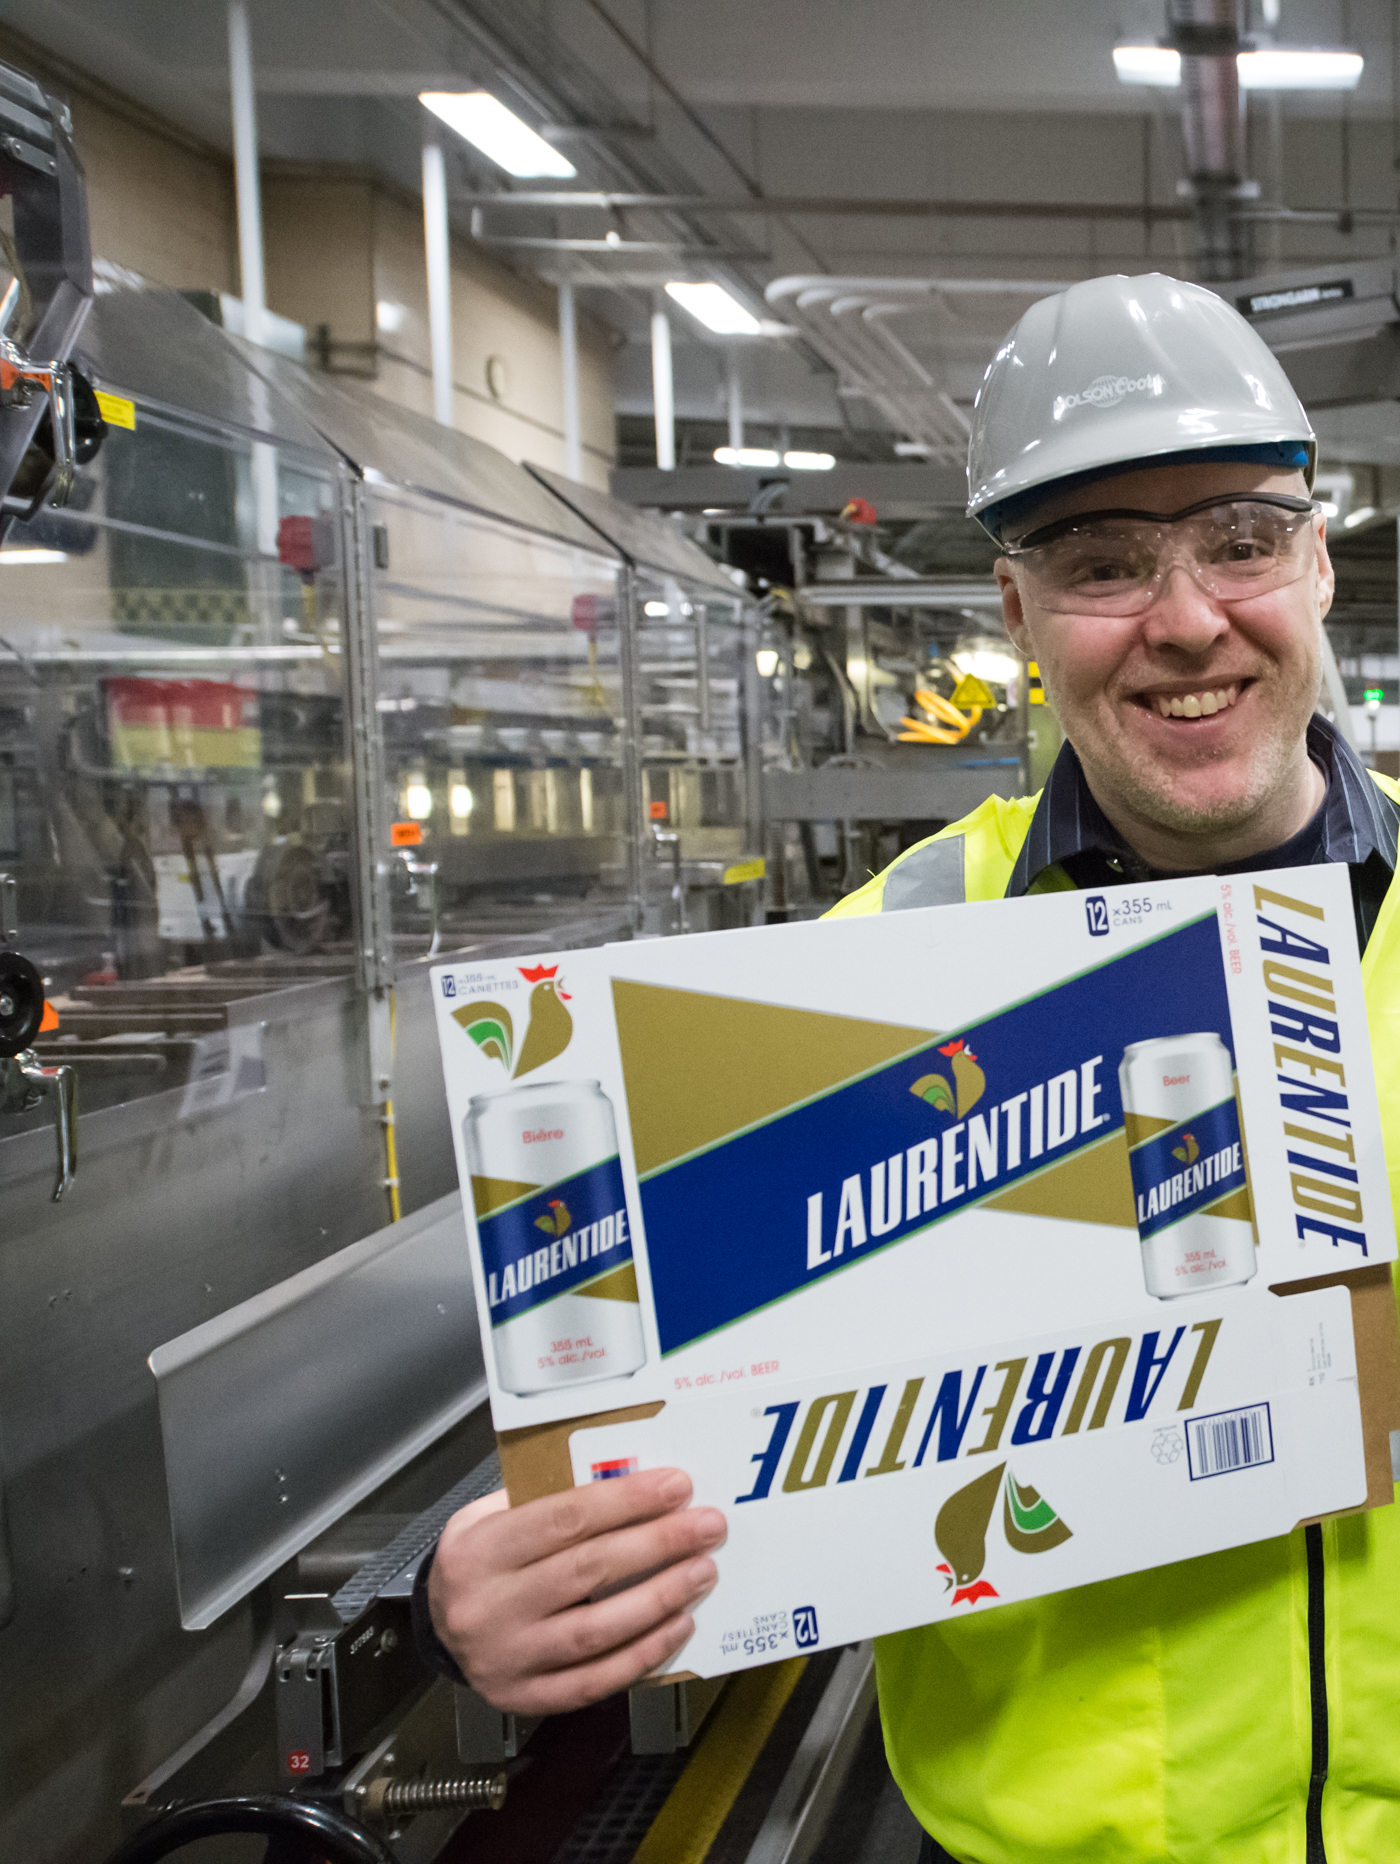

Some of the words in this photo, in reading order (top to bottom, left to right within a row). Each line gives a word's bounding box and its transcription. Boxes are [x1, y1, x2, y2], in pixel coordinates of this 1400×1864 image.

[1116, 373, 1163, 396] Coor
[1086, 900, 1108, 931] 12
[1113, 916, 1143, 927] CANS
[1220, 884, 1232, 899] 5%
[1229, 949, 1242, 975] BEER
[442, 977, 456, 997] 12
[458, 980, 519, 995] CANETTES
[1162, 1073, 1191, 1087] Beer
[1252, 883, 1369, 1257] LAURENTIDE
[522, 1128, 564, 1144] Bière
[806, 1055, 1104, 1270] LAURENTIDE
[1138, 1141, 1243, 1224] LAURENTIDE
[488, 1208, 630, 1308] LAURENTIDE
[537, 1355, 555, 1369] 5%
[674, 1376, 692, 1390] 5%
[750, 1360, 780, 1376] BEER
[734, 1318, 1224, 1505] LAURENTIDE
[752, 1611, 787, 1626] CANS
[794, 1610, 818, 1643] 12
[290, 1756, 310, 1769] 32
